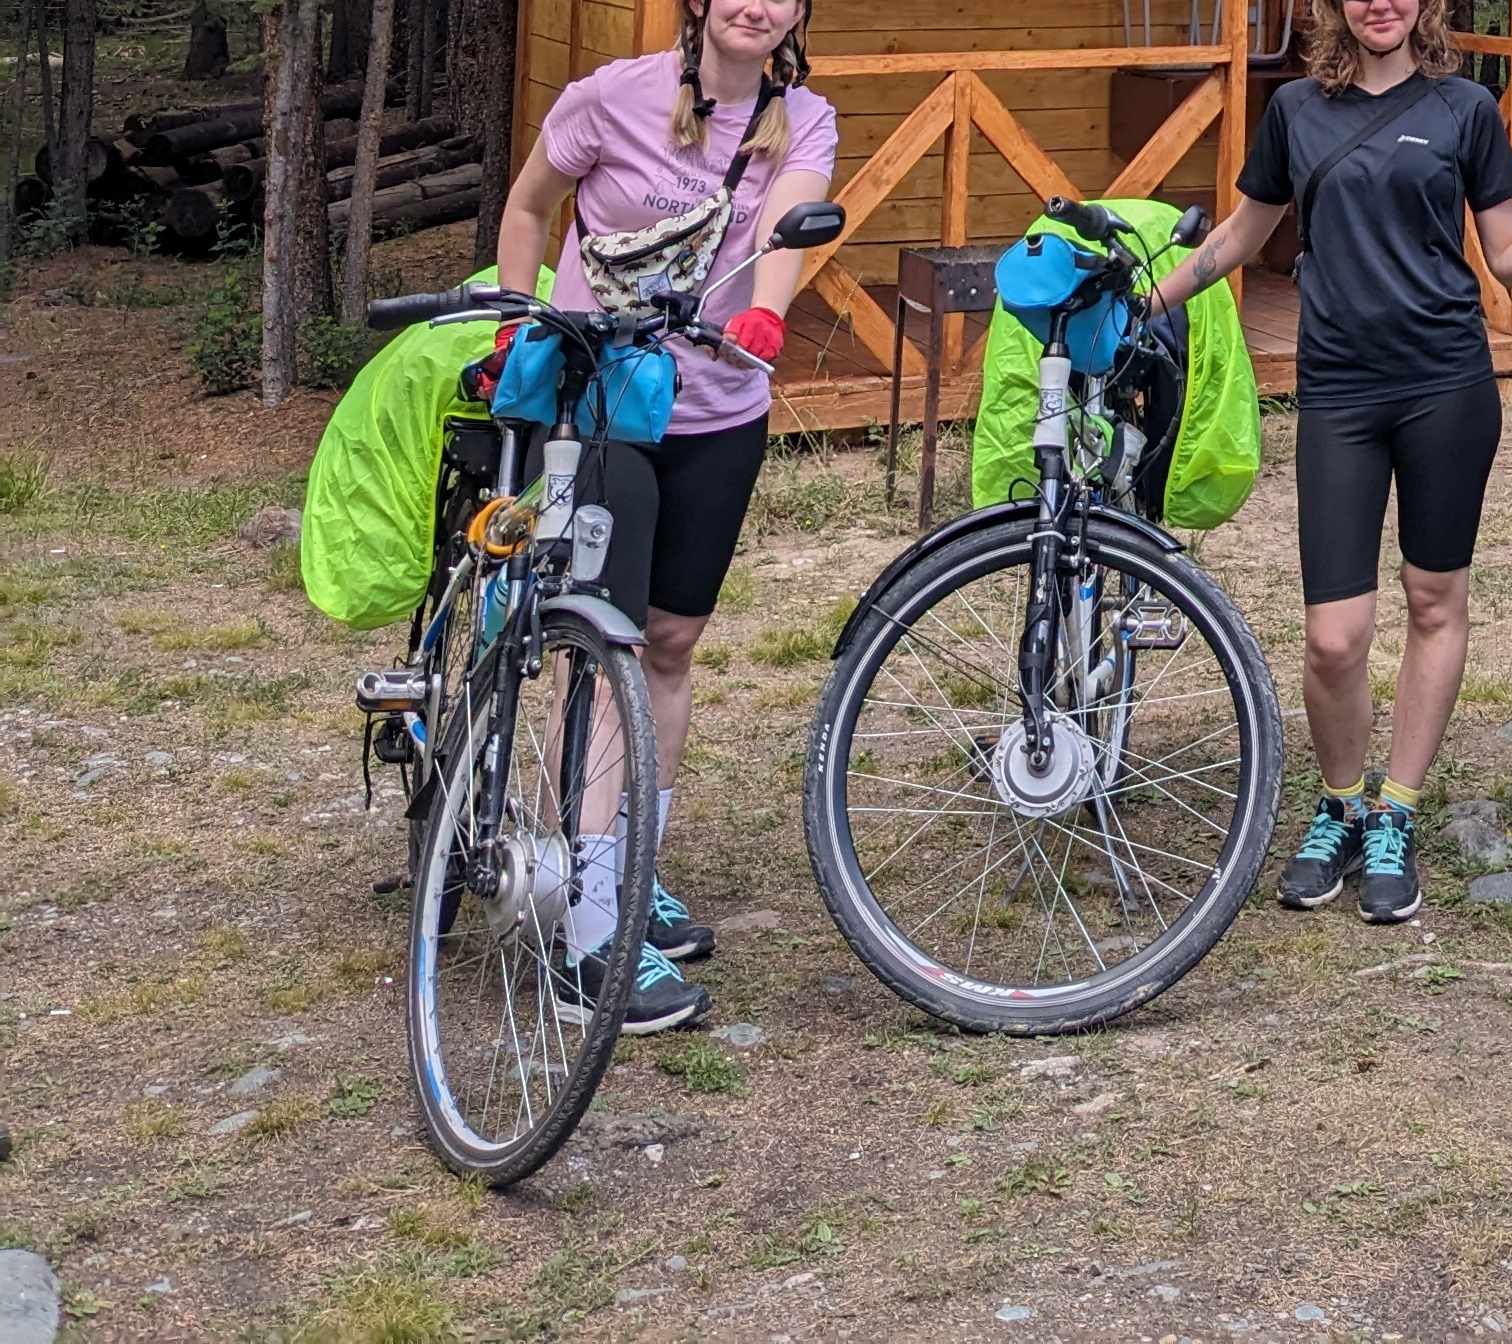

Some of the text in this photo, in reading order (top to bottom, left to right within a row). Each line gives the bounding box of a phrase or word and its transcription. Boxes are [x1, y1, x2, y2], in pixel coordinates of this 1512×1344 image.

[676, 176, 707, 194] 1973
[817, 723, 831, 773] KENDA
[940, 972, 1017, 997] KMS
